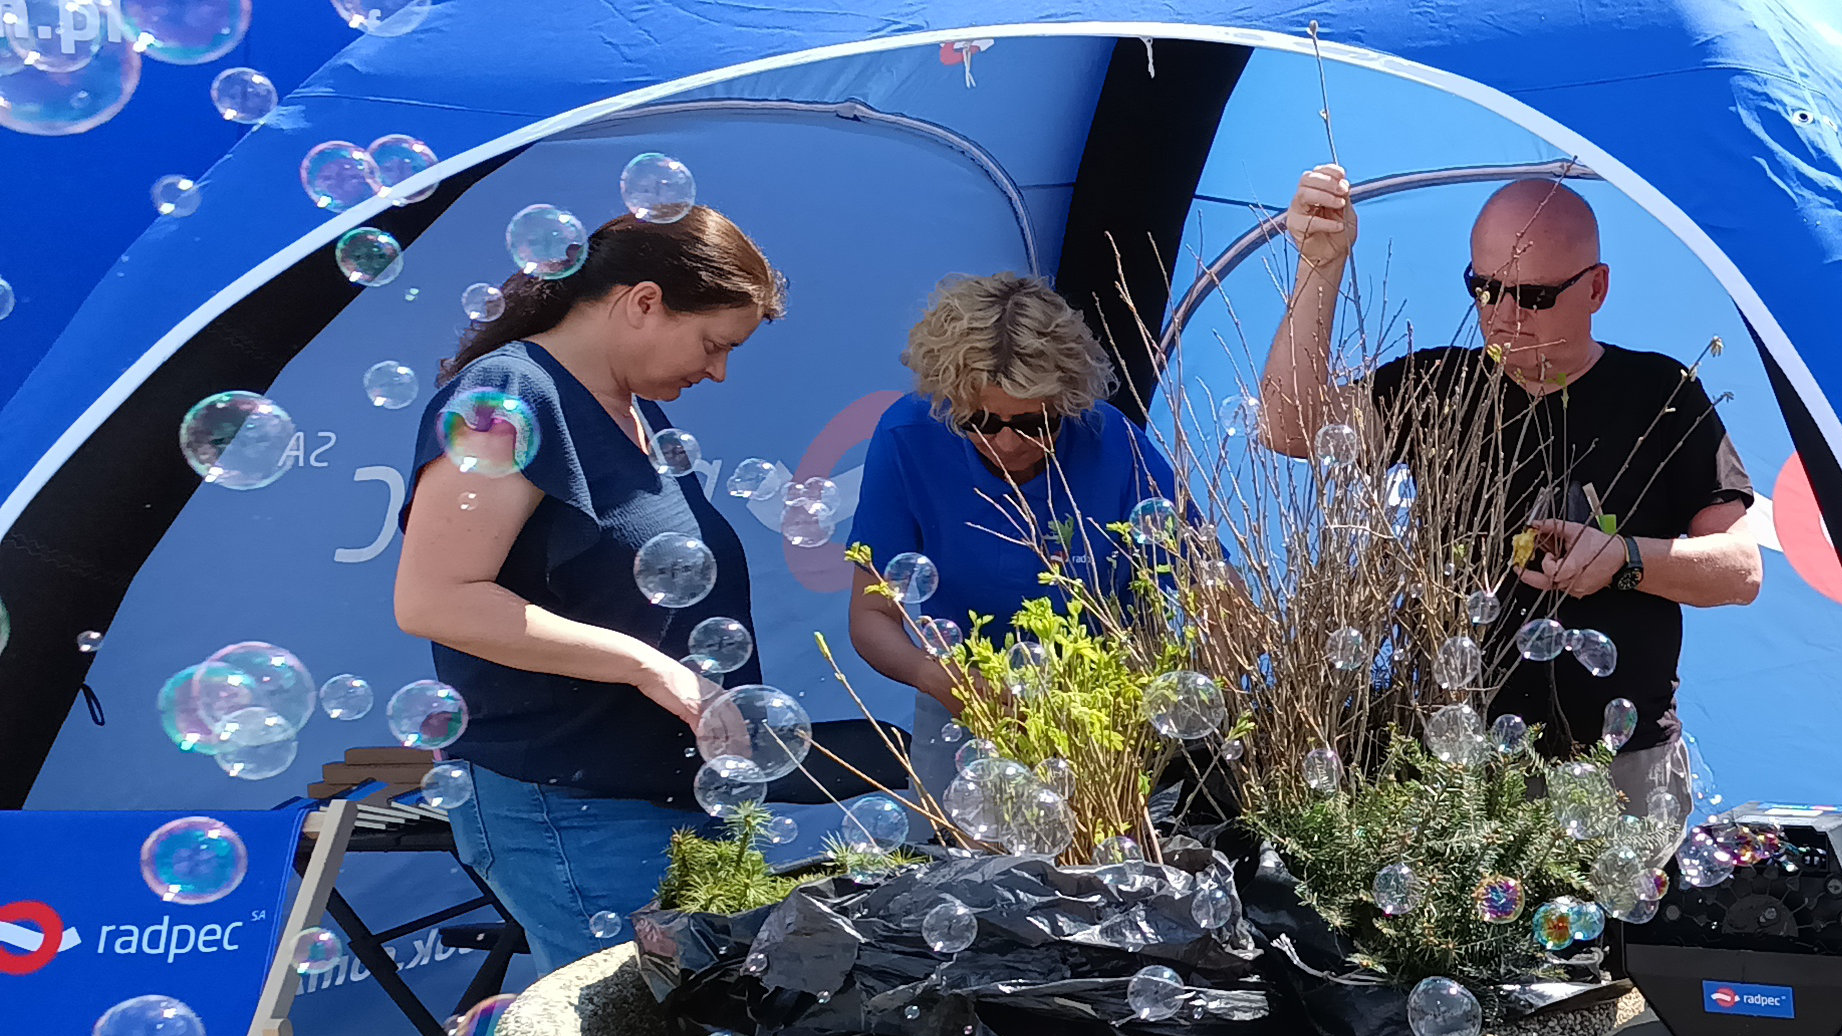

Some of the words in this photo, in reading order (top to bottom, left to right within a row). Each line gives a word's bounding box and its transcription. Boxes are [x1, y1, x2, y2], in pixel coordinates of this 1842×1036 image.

[97, 915, 243, 964] radpec
[250, 909, 267, 922] SA
[1743, 994, 1781, 1007] radpec
